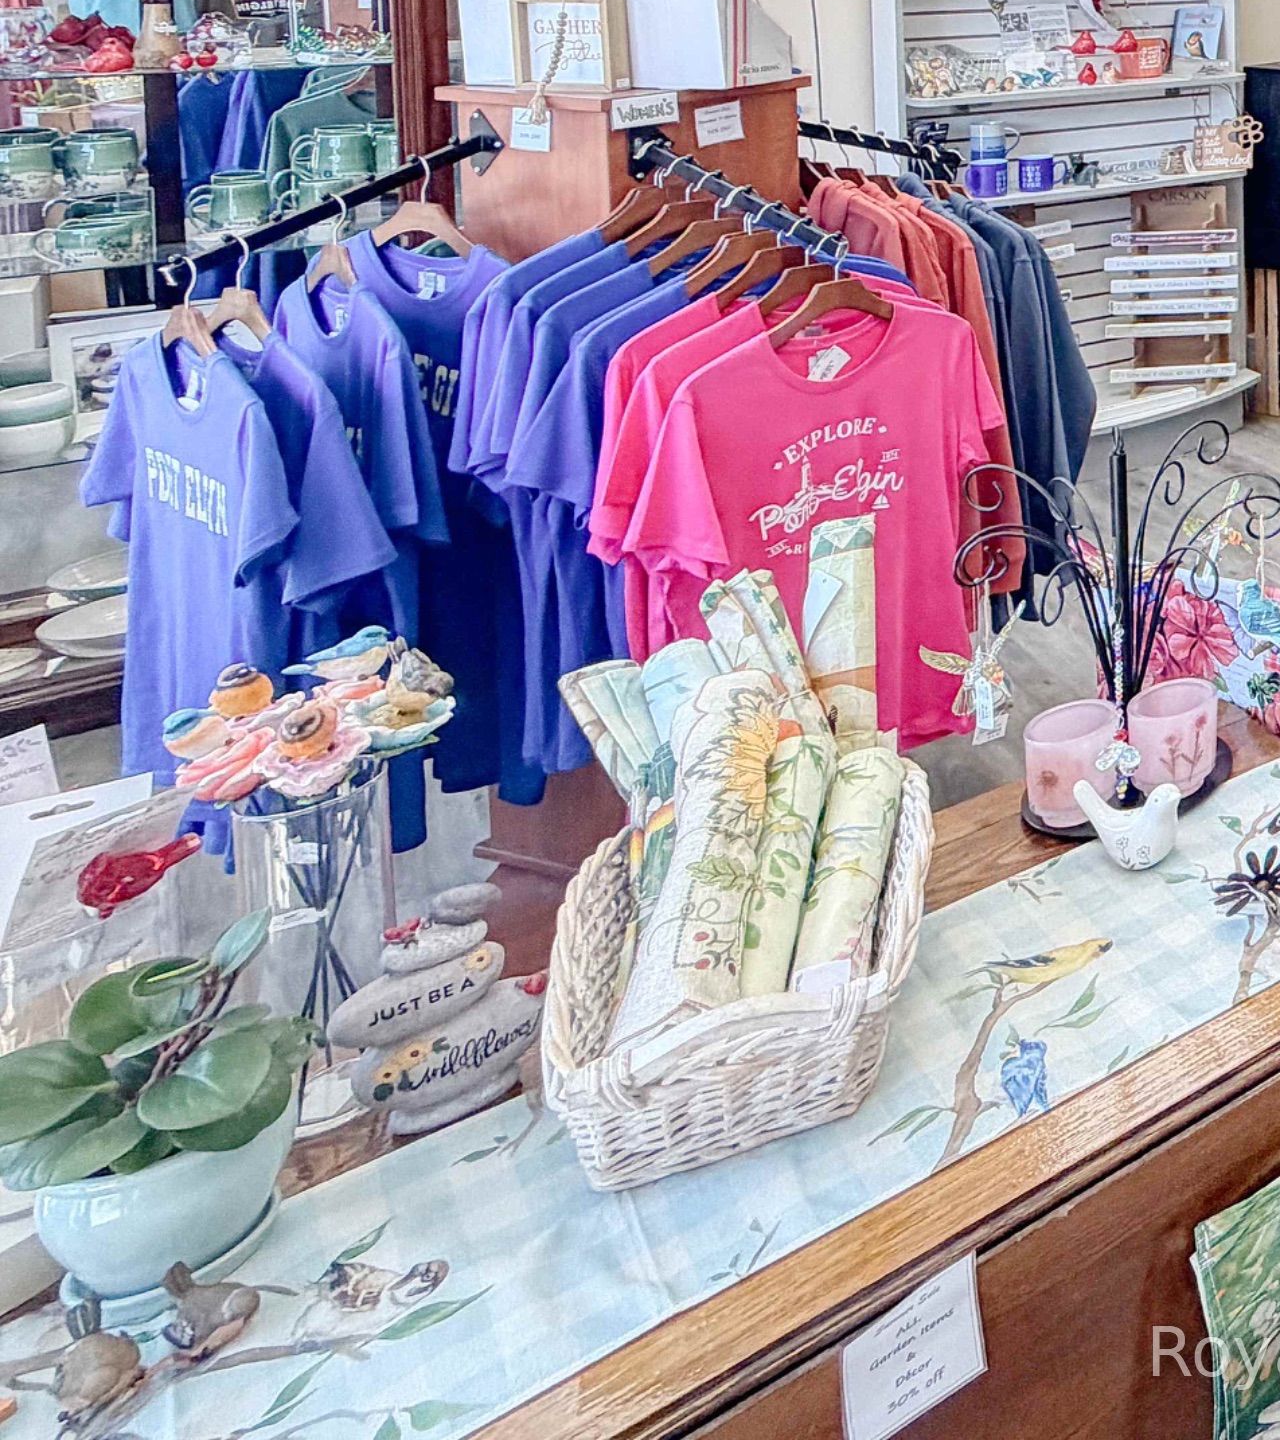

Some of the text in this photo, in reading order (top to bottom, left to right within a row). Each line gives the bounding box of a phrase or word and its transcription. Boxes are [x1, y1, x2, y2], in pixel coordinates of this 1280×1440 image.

[533, 17, 602, 36] GAHER
[616, 97, 676, 123] WOMEN'S
[1149, 188, 1208, 204] CARSON
[782, 416, 877, 465] EXPLORE
[749, 457, 905, 542] Port Elgin
[368, 976, 476, 1028] JUST BE A
[408, 1007, 544, 1092] wildflower
[917, 1285, 941, 1306] Sale
[868, 1307, 956, 1373] Garden Items
[895, 1314, 923, 1339] ALL
[886, 1364, 946, 1415] 30% off
[895, 1357, 934, 1389] Décor
